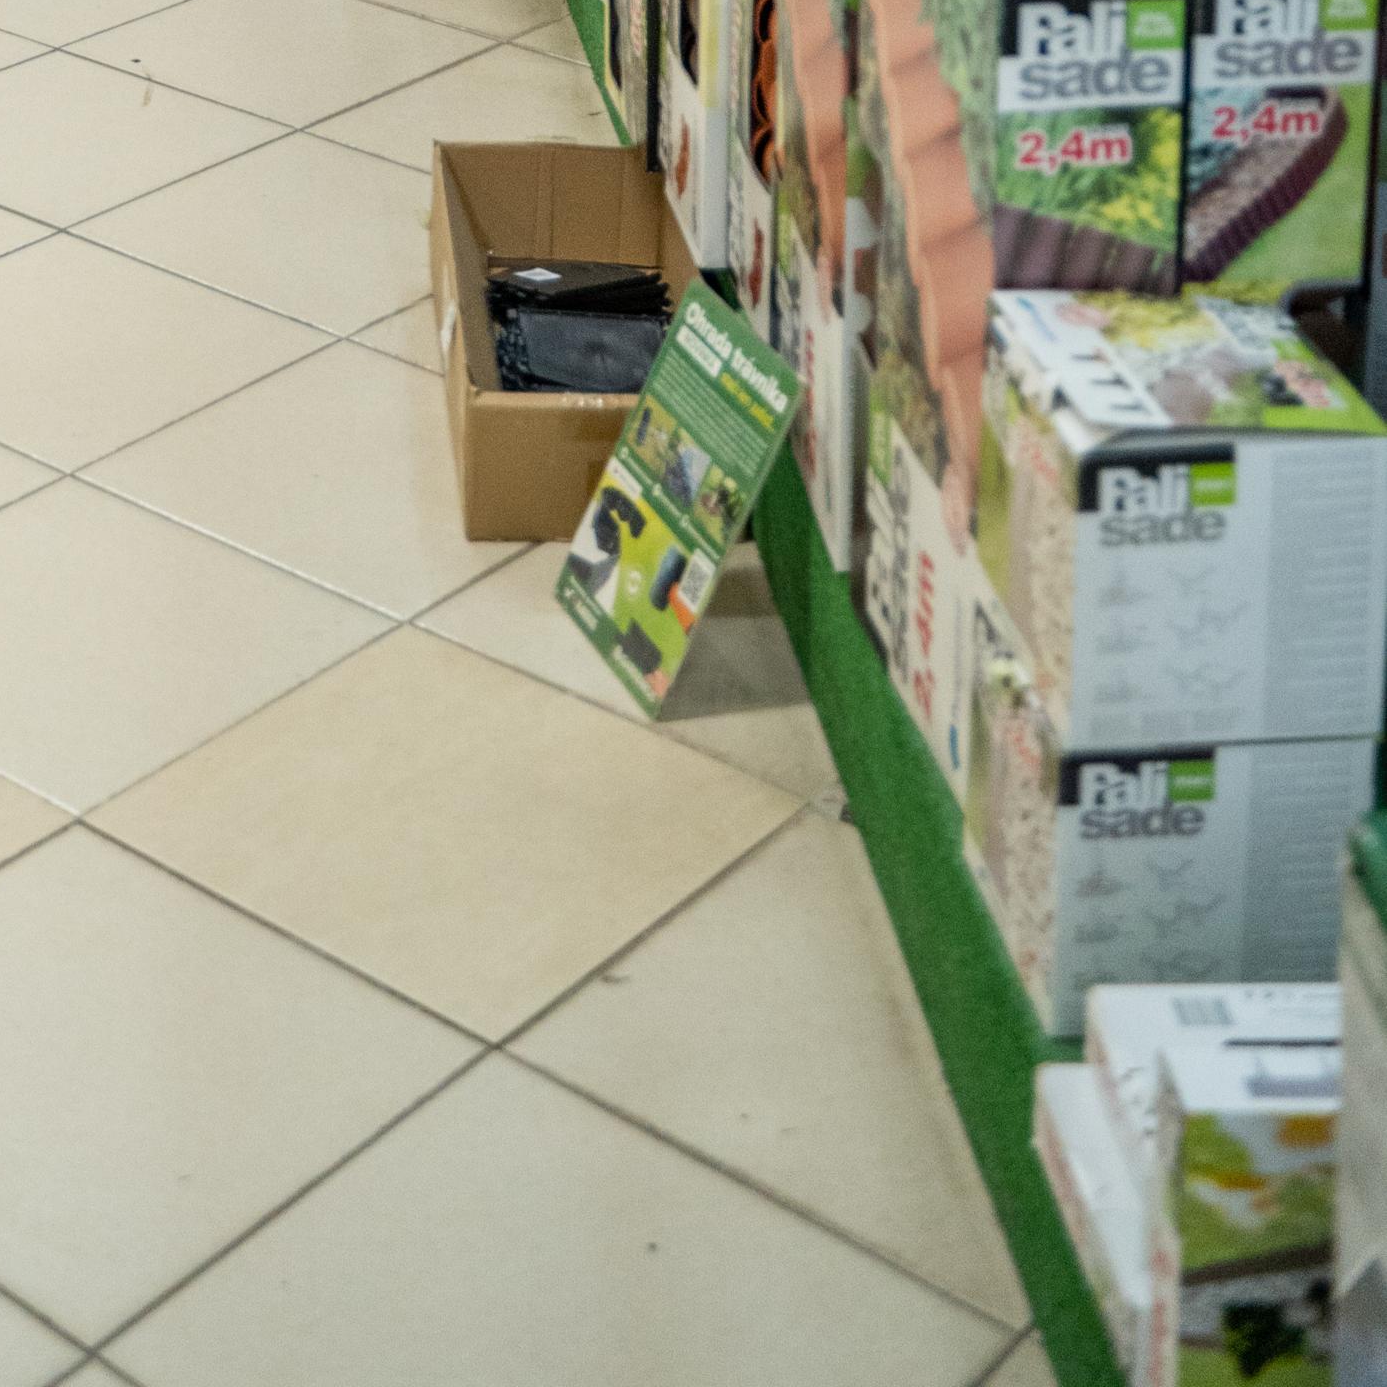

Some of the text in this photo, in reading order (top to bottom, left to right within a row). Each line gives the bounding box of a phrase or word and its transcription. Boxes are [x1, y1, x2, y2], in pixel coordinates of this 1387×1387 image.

[1017, 1, 1126, 59] Pali
[1019, 50, 1172, 102] sade
[1216, 32, 1363, 80] sade
[1212, 103, 1322, 141] 2,4m
[1018, 131, 1134, 170] 2,4m
[1097, 465, 1189, 514] Pali
[1098, 512, 1226, 547] sade
[1078, 761, 1168, 806] Pali
[1078, 802, 1205, 839] sade
